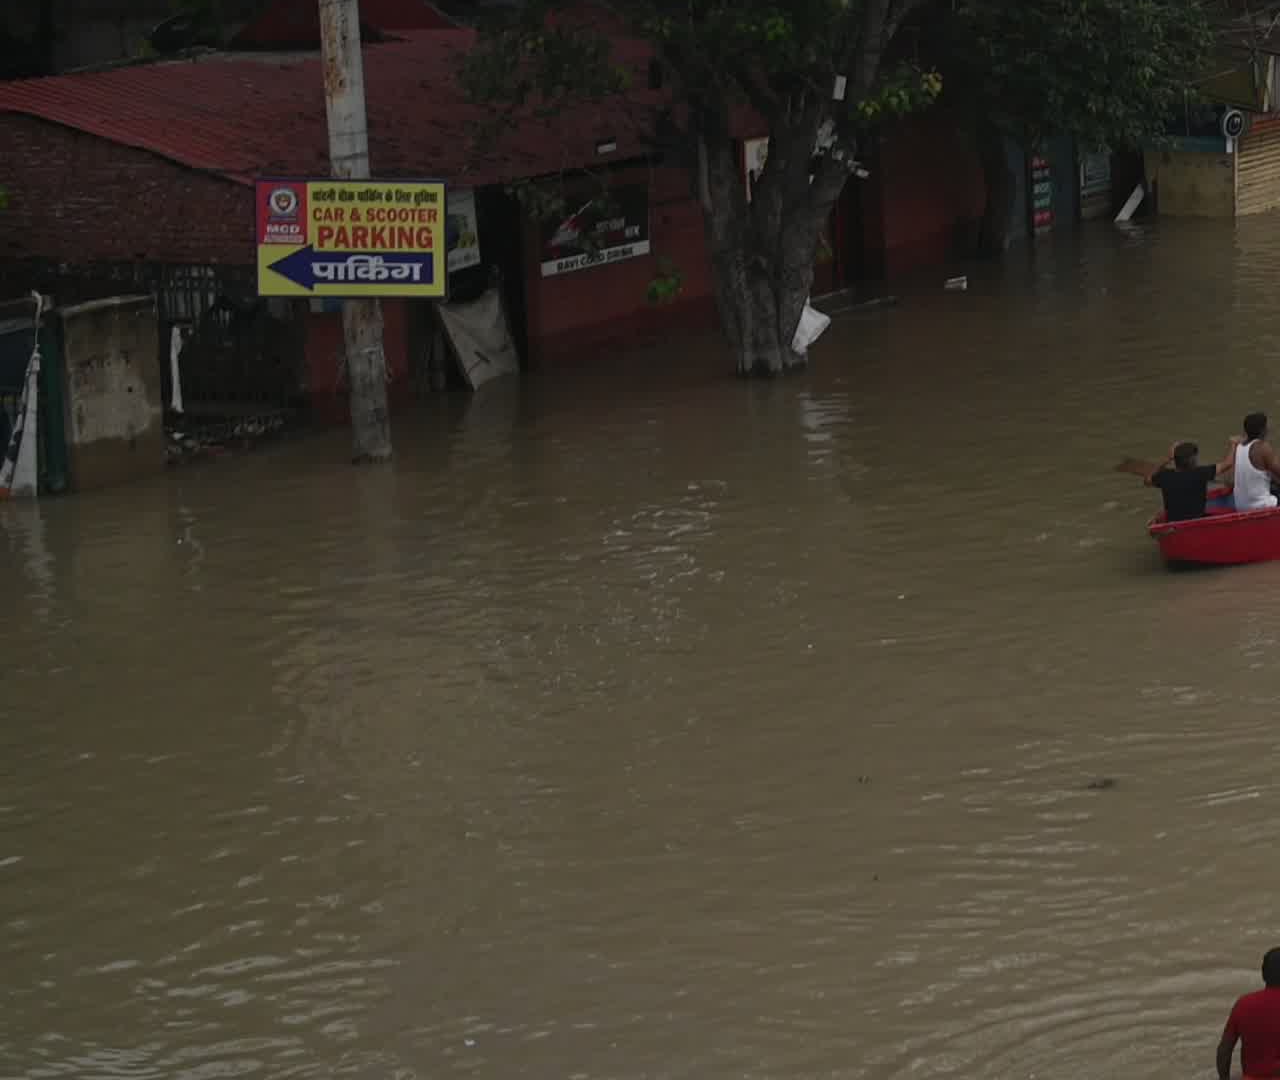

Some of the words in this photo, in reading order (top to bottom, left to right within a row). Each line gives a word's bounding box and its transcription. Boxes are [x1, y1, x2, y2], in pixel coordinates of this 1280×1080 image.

[313, 207, 345, 222] CAR
[350, 207, 361, 222] &
[366, 207, 438, 223] SCOOTER
[266, 223, 300, 233] MCD
[317, 226, 433, 249] PARKING
[311, 255, 424, 281] पार्किंग
